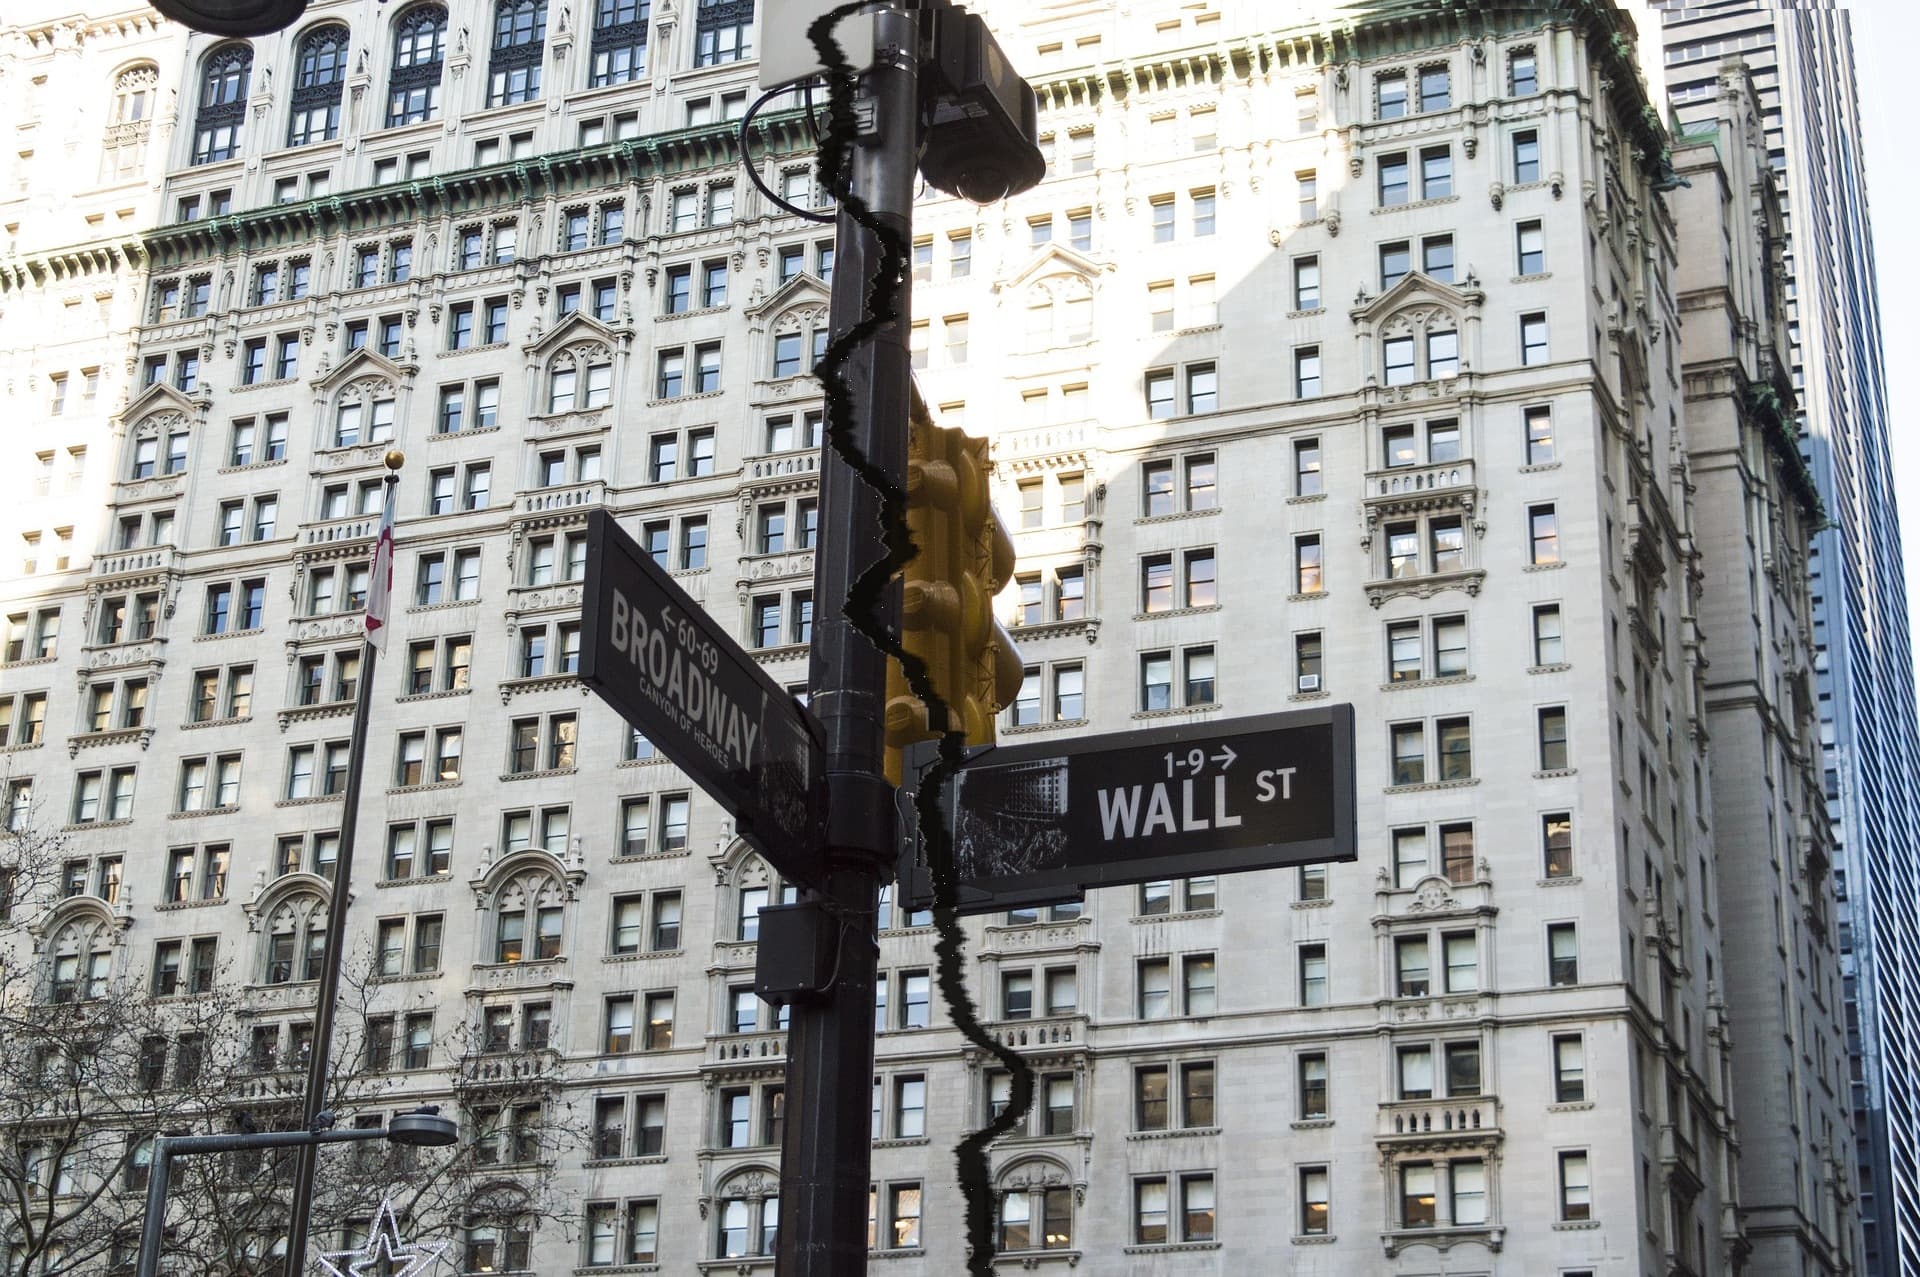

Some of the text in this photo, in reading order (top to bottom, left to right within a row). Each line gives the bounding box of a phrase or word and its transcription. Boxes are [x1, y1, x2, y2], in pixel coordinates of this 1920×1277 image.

[611, 588, 757, 771] BROADWAY
[678, 618, 718, 674] 60-69
[639, 678, 729, 769] CANYON OF HEROES
[1164, 748, 1204, 778] 1-9
[1098, 767, 1297, 841] WALL ST
